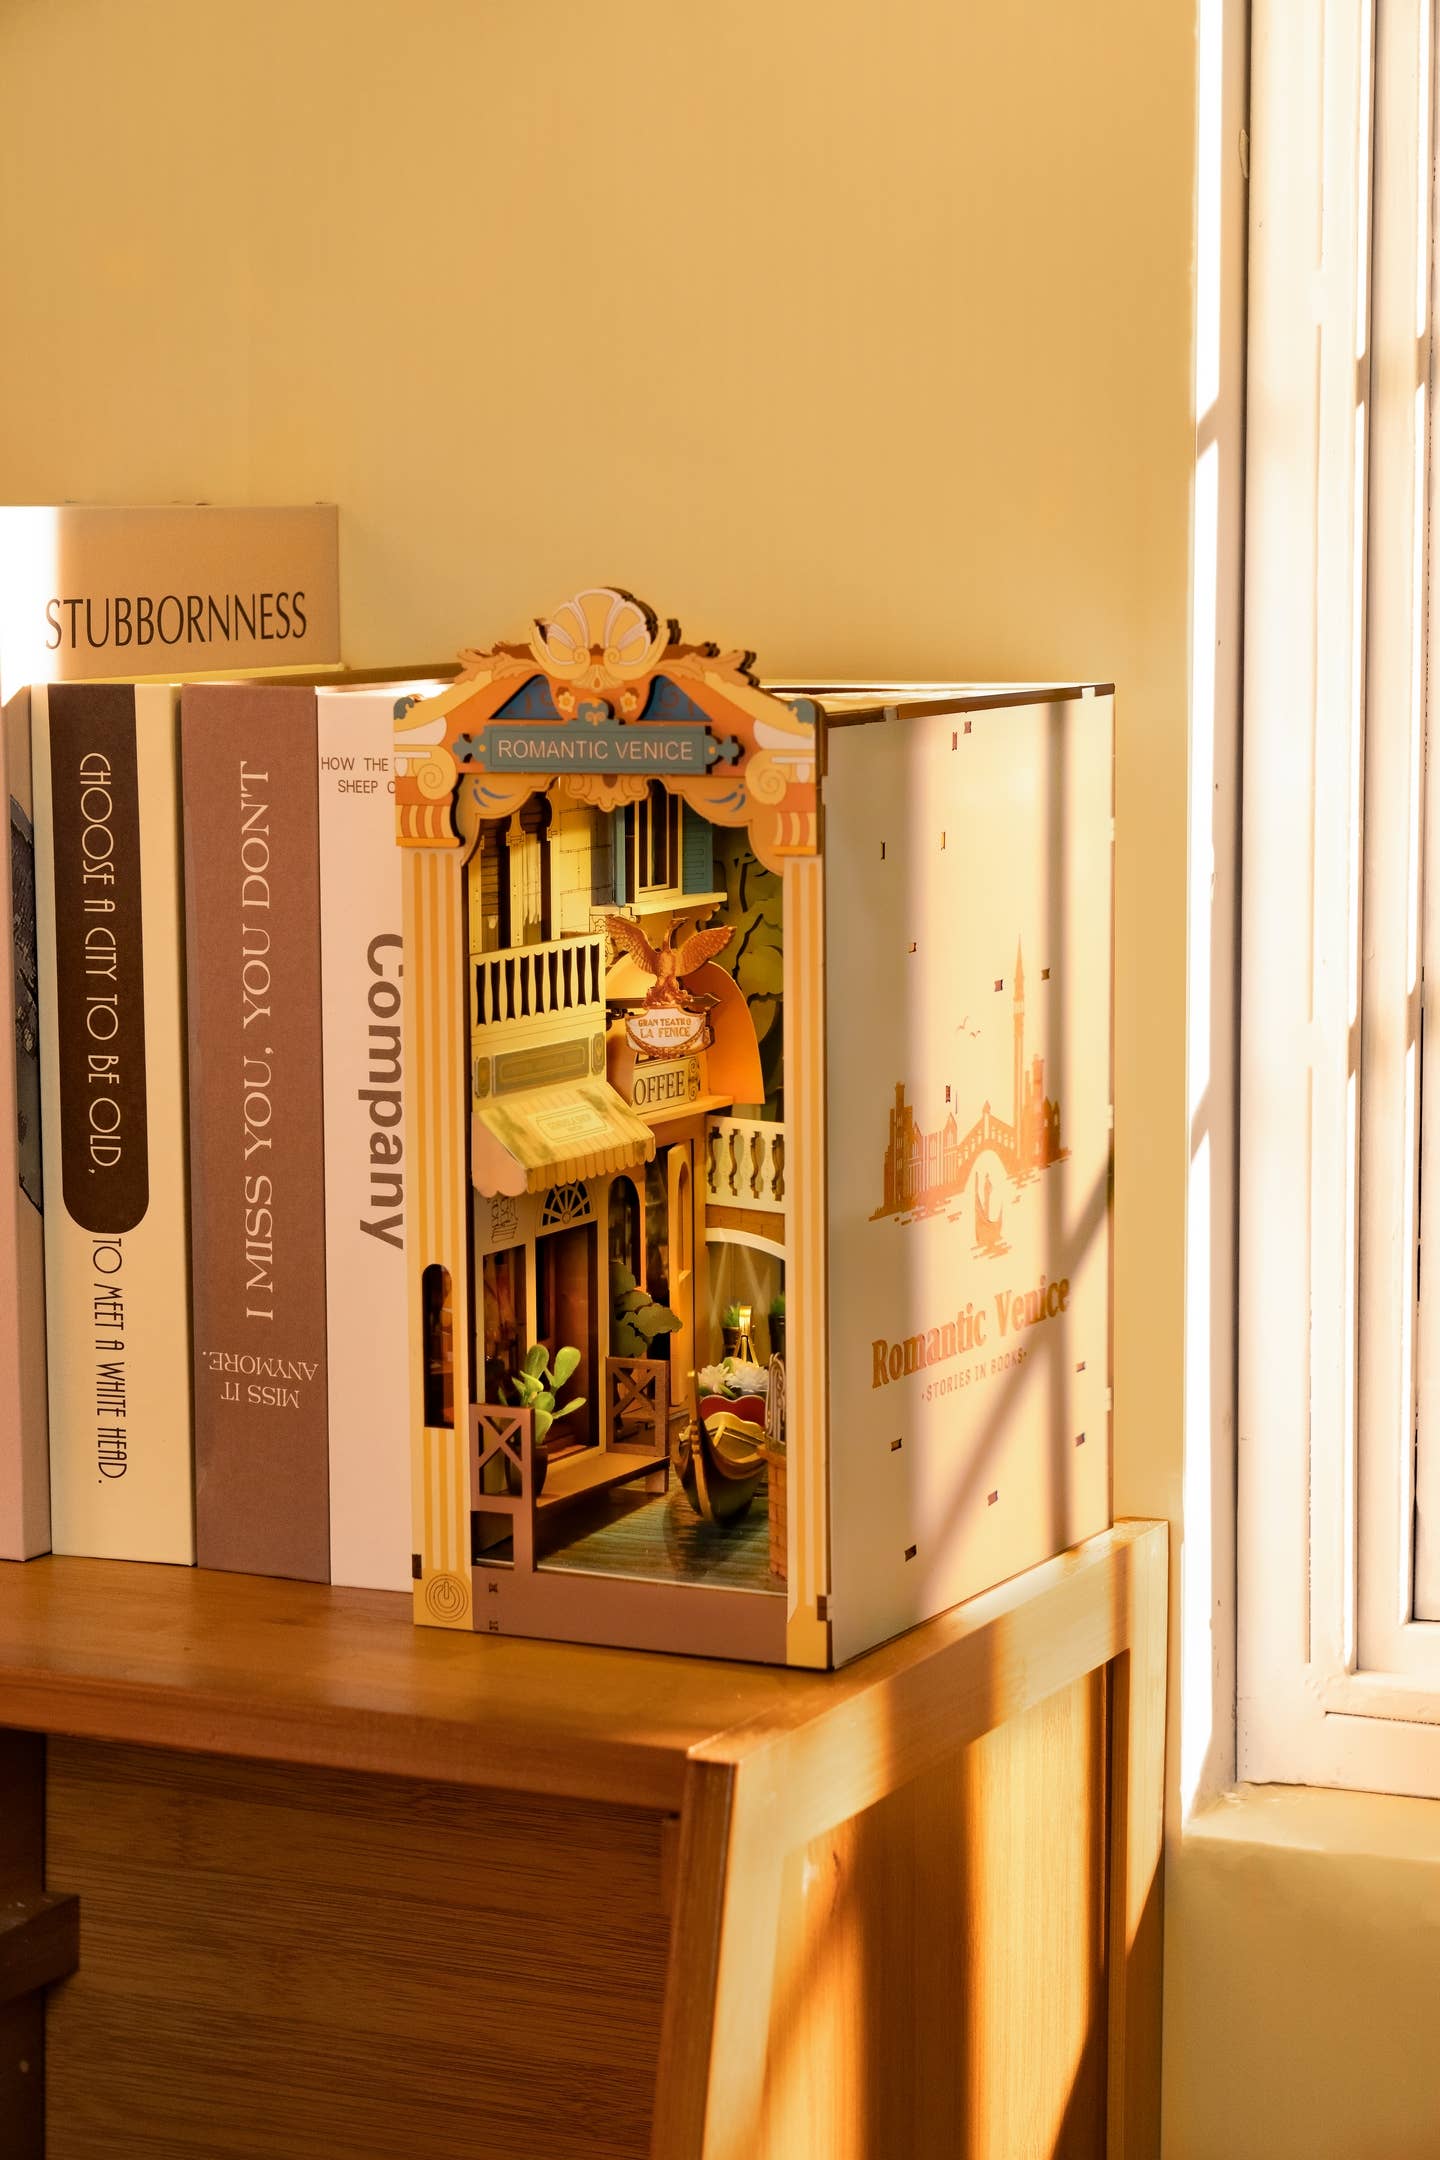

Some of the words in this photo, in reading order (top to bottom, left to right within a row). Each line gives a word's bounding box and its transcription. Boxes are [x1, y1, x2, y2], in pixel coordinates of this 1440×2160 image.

[45, 591, 307, 650] STUBBORNNESS
[320, 756, 355, 771] HOW
[363, 757, 389, 772] THE
[498, 739, 609, 760] ROMANTIC
[615, 740, 693, 761] VENICE
[337, 779, 378, 794] SHEEP
[79, 752, 115, 885] CHOOSE
[240, 760, 271, 910] DON'T
[84, 898, 116, 912] A
[84, 927, 117, 982] CITY
[242, 922, 272, 1030] YOU
[86, 993, 119, 1041] TO
[638, 1018, 659, 1027] GRAN
[660, 1017, 692, 1027] TEATRO
[640, 1028, 654, 1038] LA
[658, 1026, 691, 1038] FENICE
[87, 1054, 120, 1084] BE
[243, 1046, 274, 1161] YOU,
[357, 932, 404, 1251] Company
[88, 1097, 122, 1174] OLD,
[244, 1175, 274, 1294] MISS
[92, 1238, 123, 1274] TO
[93, 1283, 124, 1330] MEET
[246, 1307, 274, 1321] I
[95, 1339, 125, 1351] A
[871, 1302, 987, 1389] Romantic
[994, 1274, 1071, 1337] Venice
[202, 1351, 320, 1381] ANYMORE.
[975, 1361, 986, 1381] IN
[95, 1362, 126, 1418] WHITE
[220, 1381, 240, 1402] IT
[247, 1384, 300, 1409] MISS
[97, 1427, 127, 1484] HEAD.
